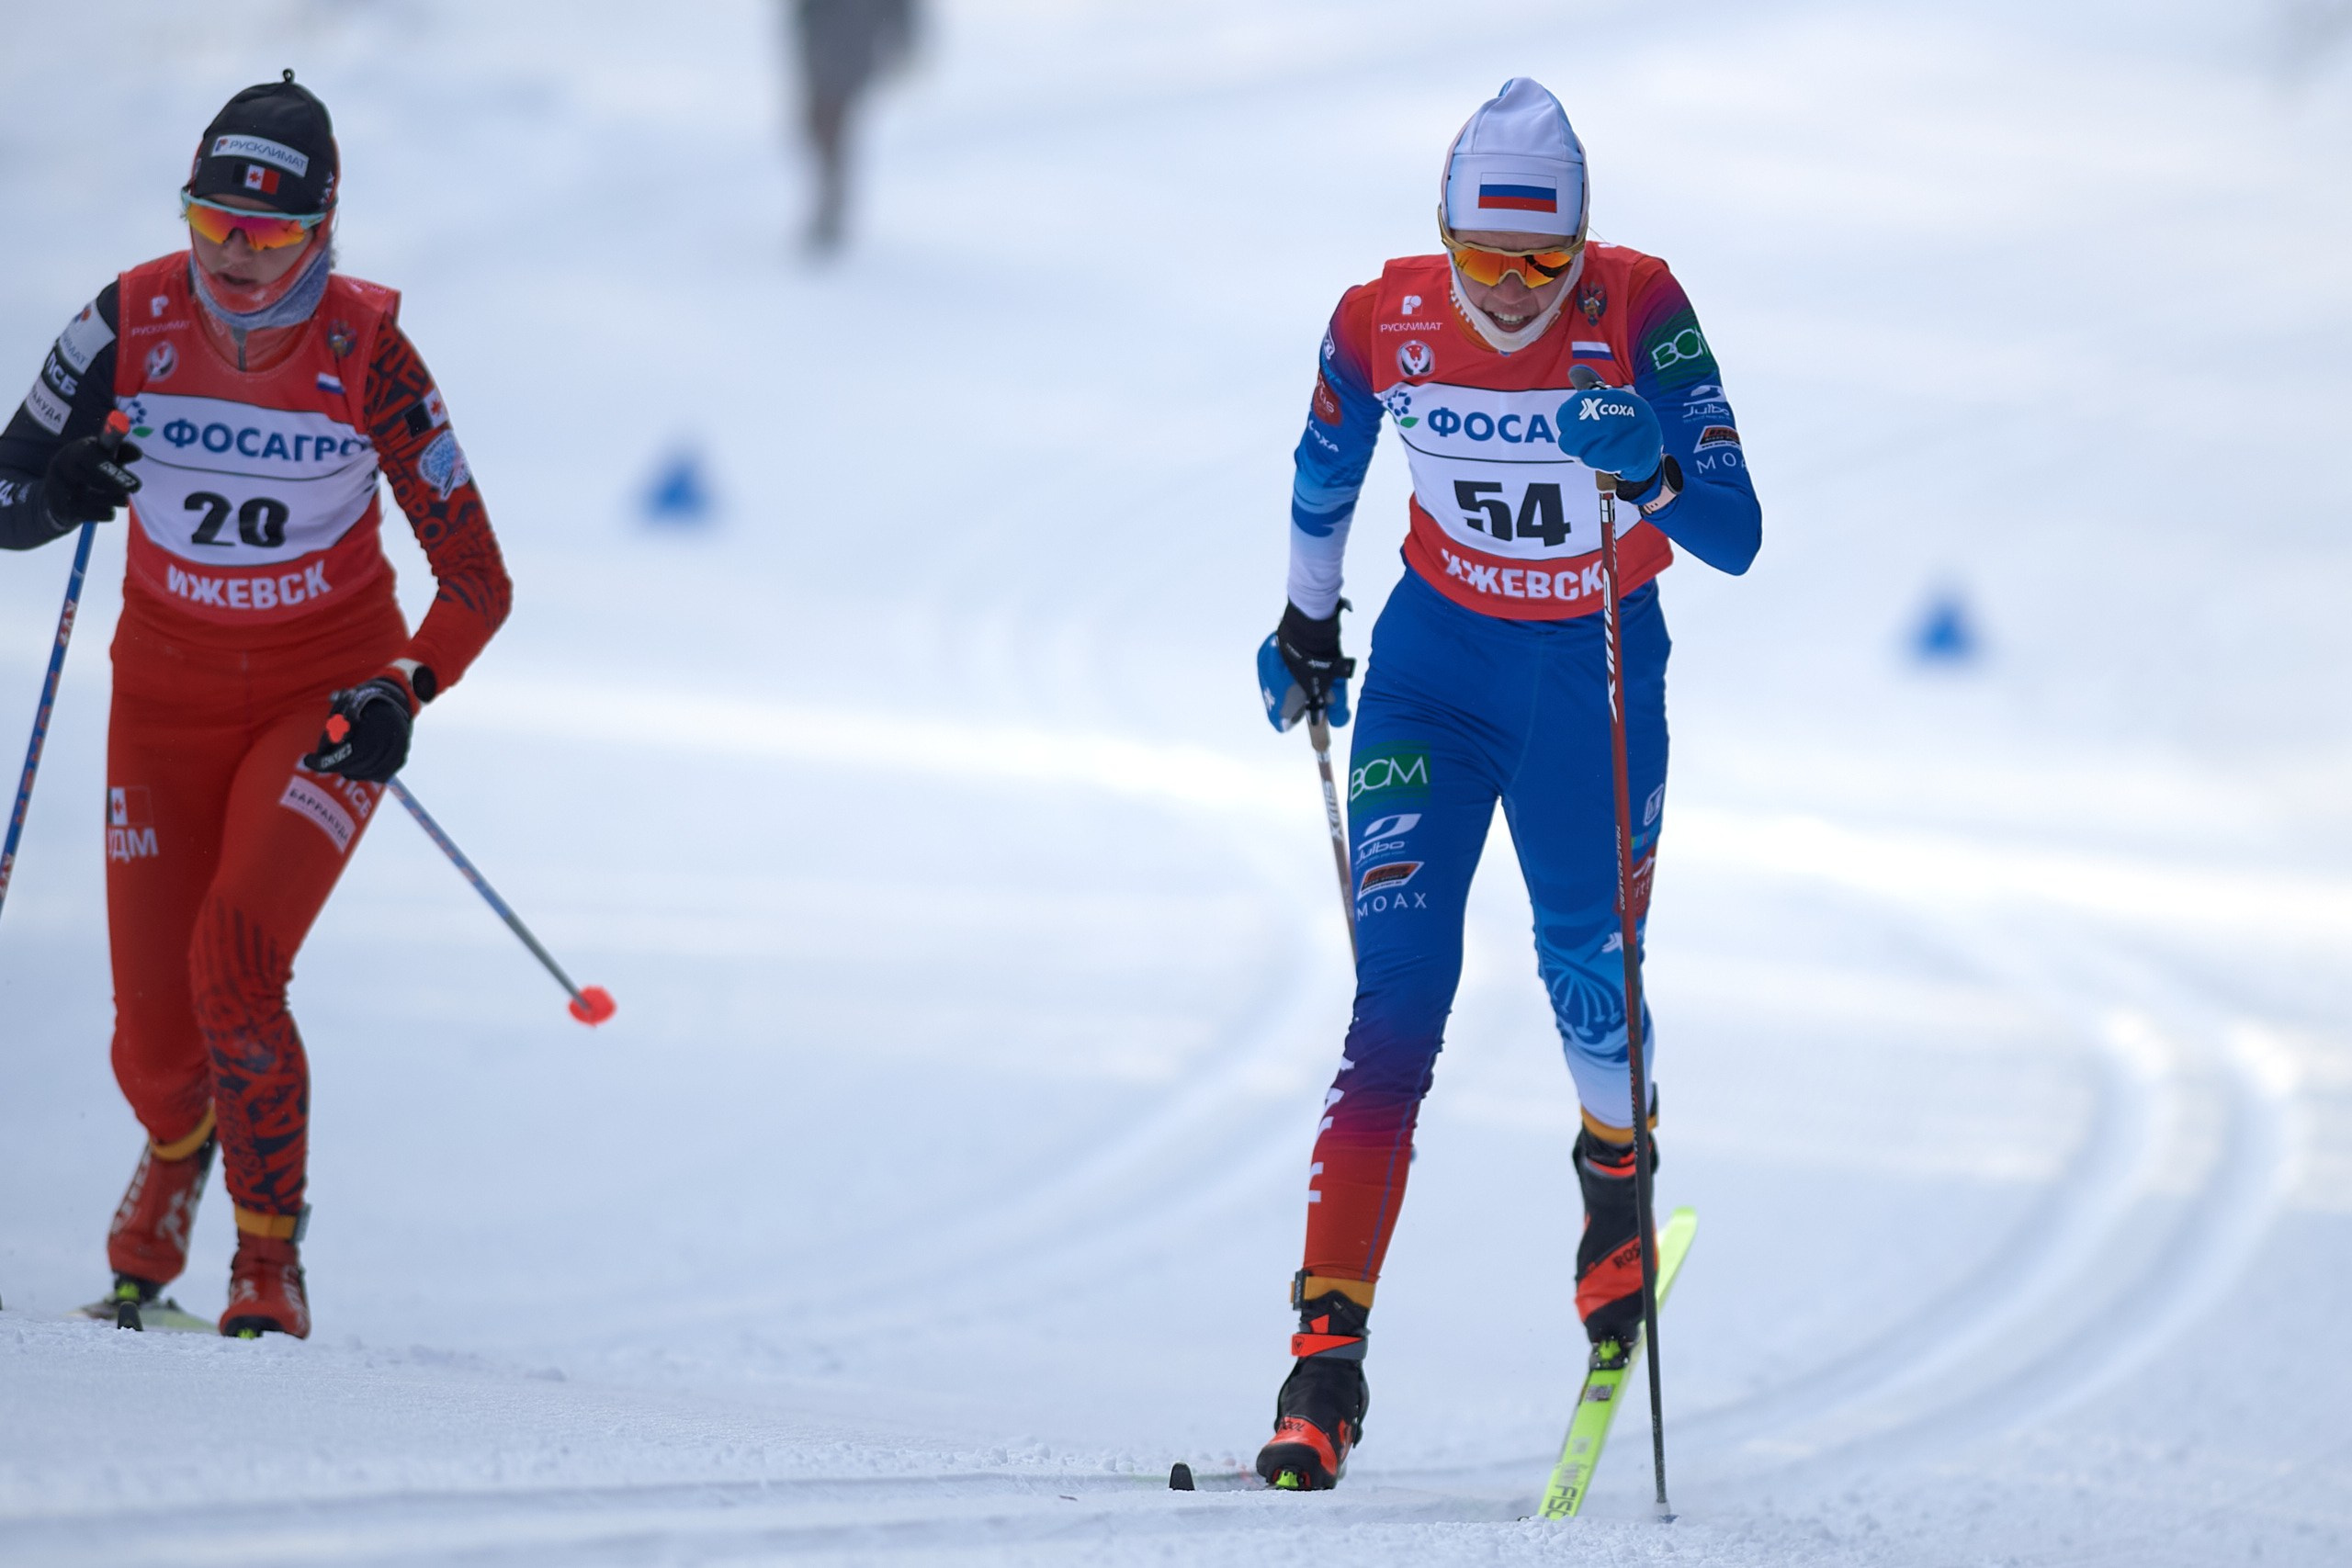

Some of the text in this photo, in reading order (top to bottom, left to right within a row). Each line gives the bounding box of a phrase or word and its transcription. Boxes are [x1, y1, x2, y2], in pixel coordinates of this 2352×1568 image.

[229, 140, 307, 168] РУСКЛИМАТ
[1380, 321, 1443, 333] РУСКЛИМАТ
[1427, 406, 1556, 444] ФОСА
[184, 491, 290, 548] 20
[1453, 479, 1572, 547] 54
[166, 560, 333, 610] ИЖЕВСК
[1350, 756, 1429, 802] BCM
[1355, 840, 1406, 865] Julbo
[1356, 892, 1427, 922] MOAX
